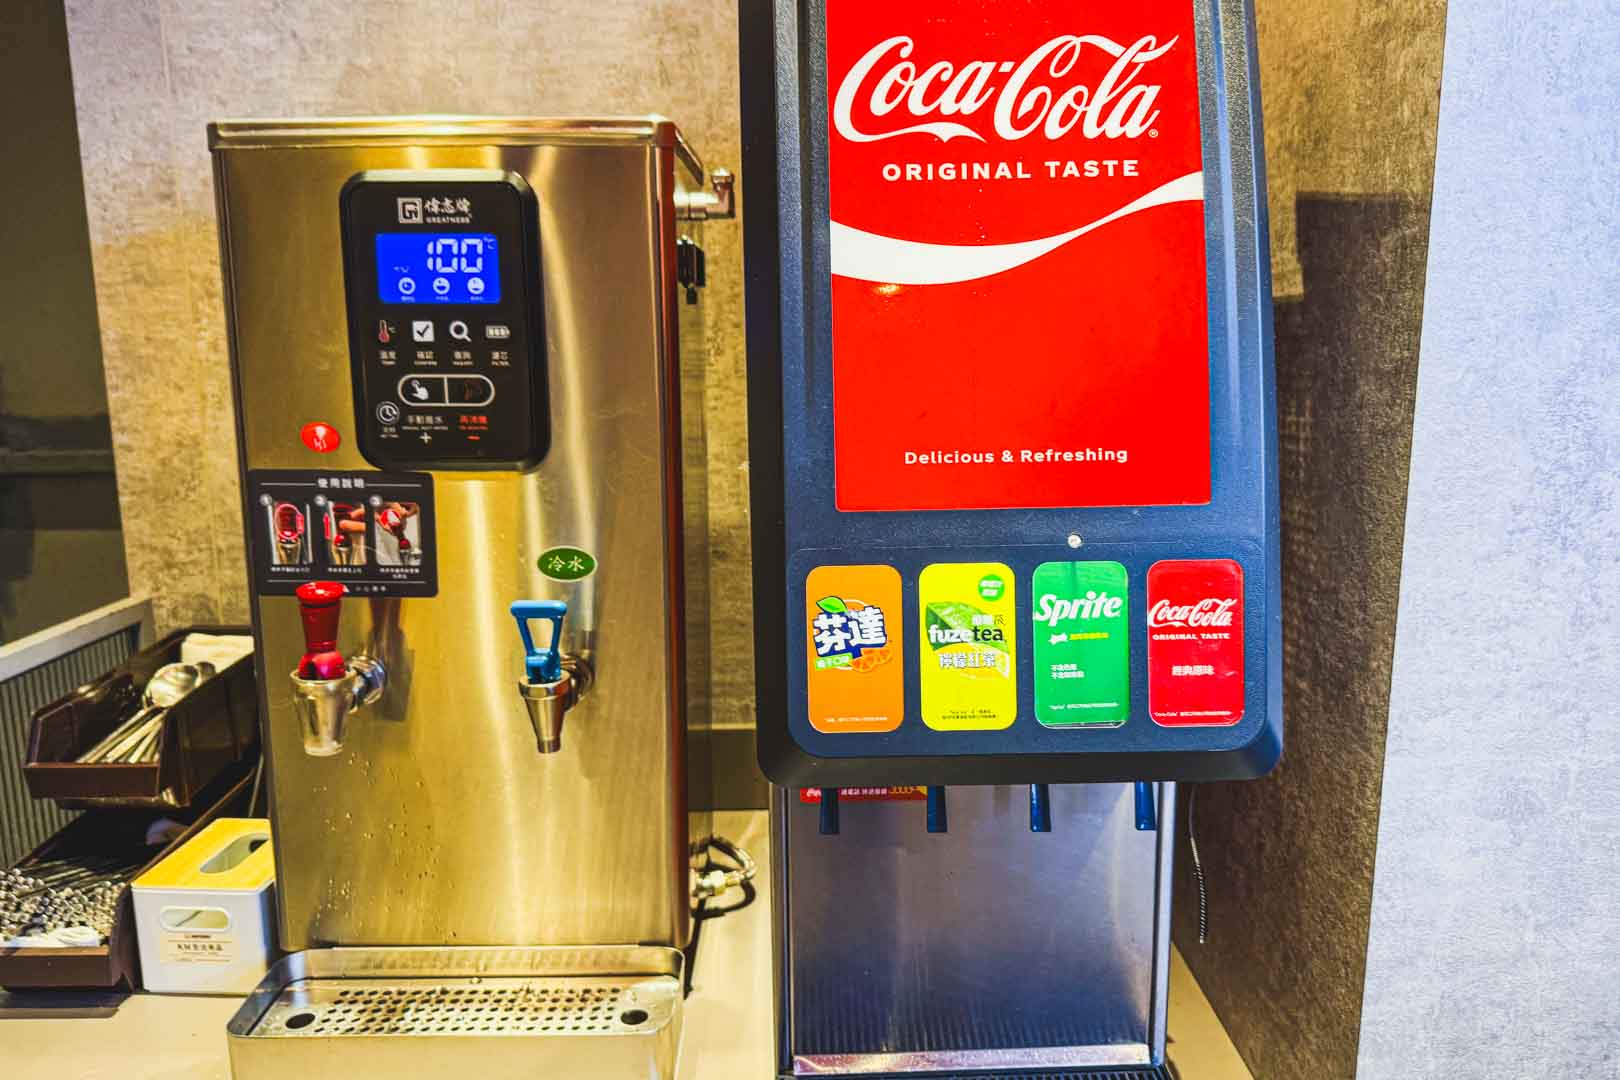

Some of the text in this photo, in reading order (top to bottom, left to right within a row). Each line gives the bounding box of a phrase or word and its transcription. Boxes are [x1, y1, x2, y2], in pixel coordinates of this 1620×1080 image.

[833, 34, 1179, 143] Coca-Cola
[882, 158, 1140, 182] ORIGINAL TASTE
[427, 238, 483, 273] 100
[904, 447, 1129, 465] Delicious & Refreshing
[317, 477, 365, 489] 使用說明
[547, 554, 585, 572] 冷水
[1032, 590, 1122, 627] Sprite
[1148, 598, 1237, 628] Coca-Cola
[813, 606, 887, 655] 芬達
[1152, 632, 1231, 641] ORIGINAL TASTE
